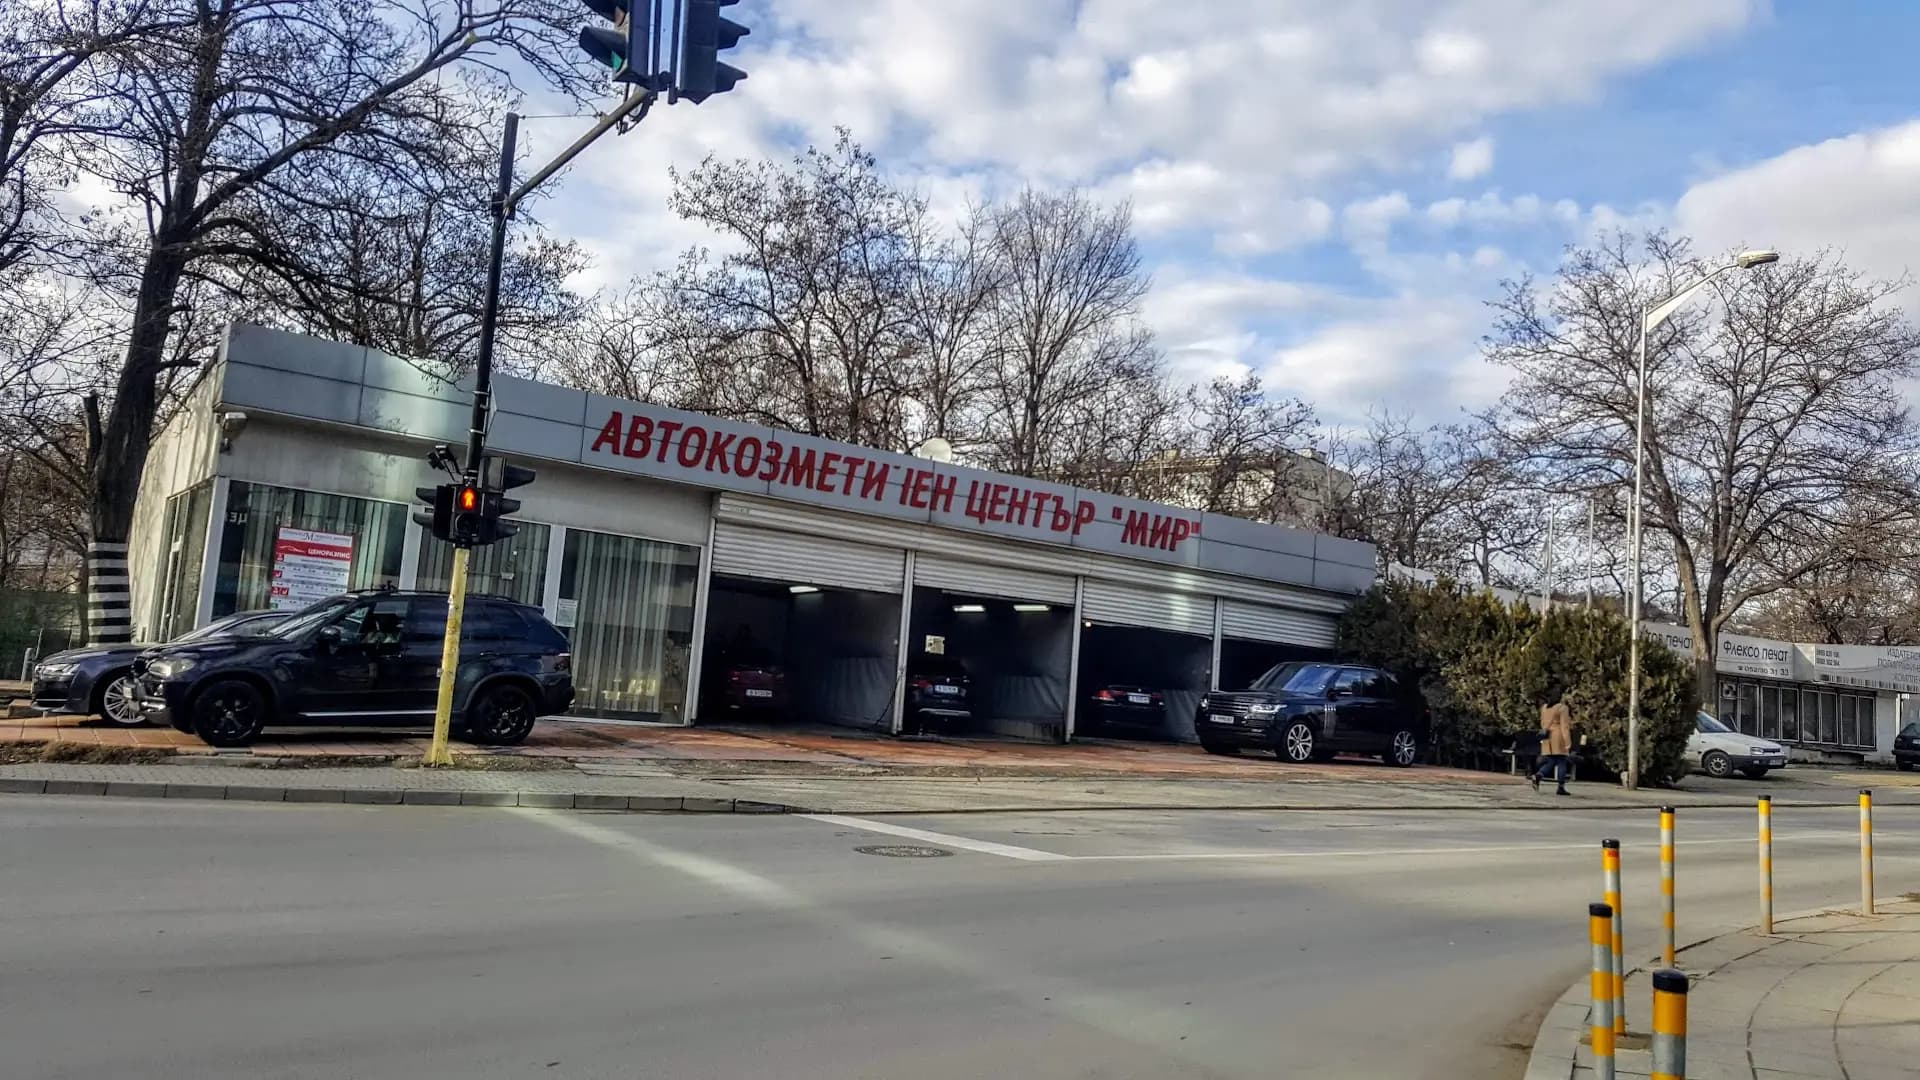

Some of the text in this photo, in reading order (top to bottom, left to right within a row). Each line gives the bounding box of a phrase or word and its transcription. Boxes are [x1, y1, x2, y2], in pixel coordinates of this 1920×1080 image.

[965, 480, 1096, 536] ЦЕНТЪР
[1111, 506, 1202, 551] "МИР"
[307, 548, 351, 559] ЦЕНОРАЗПИС
[1723, 640, 1789, 662] Флексо печат
